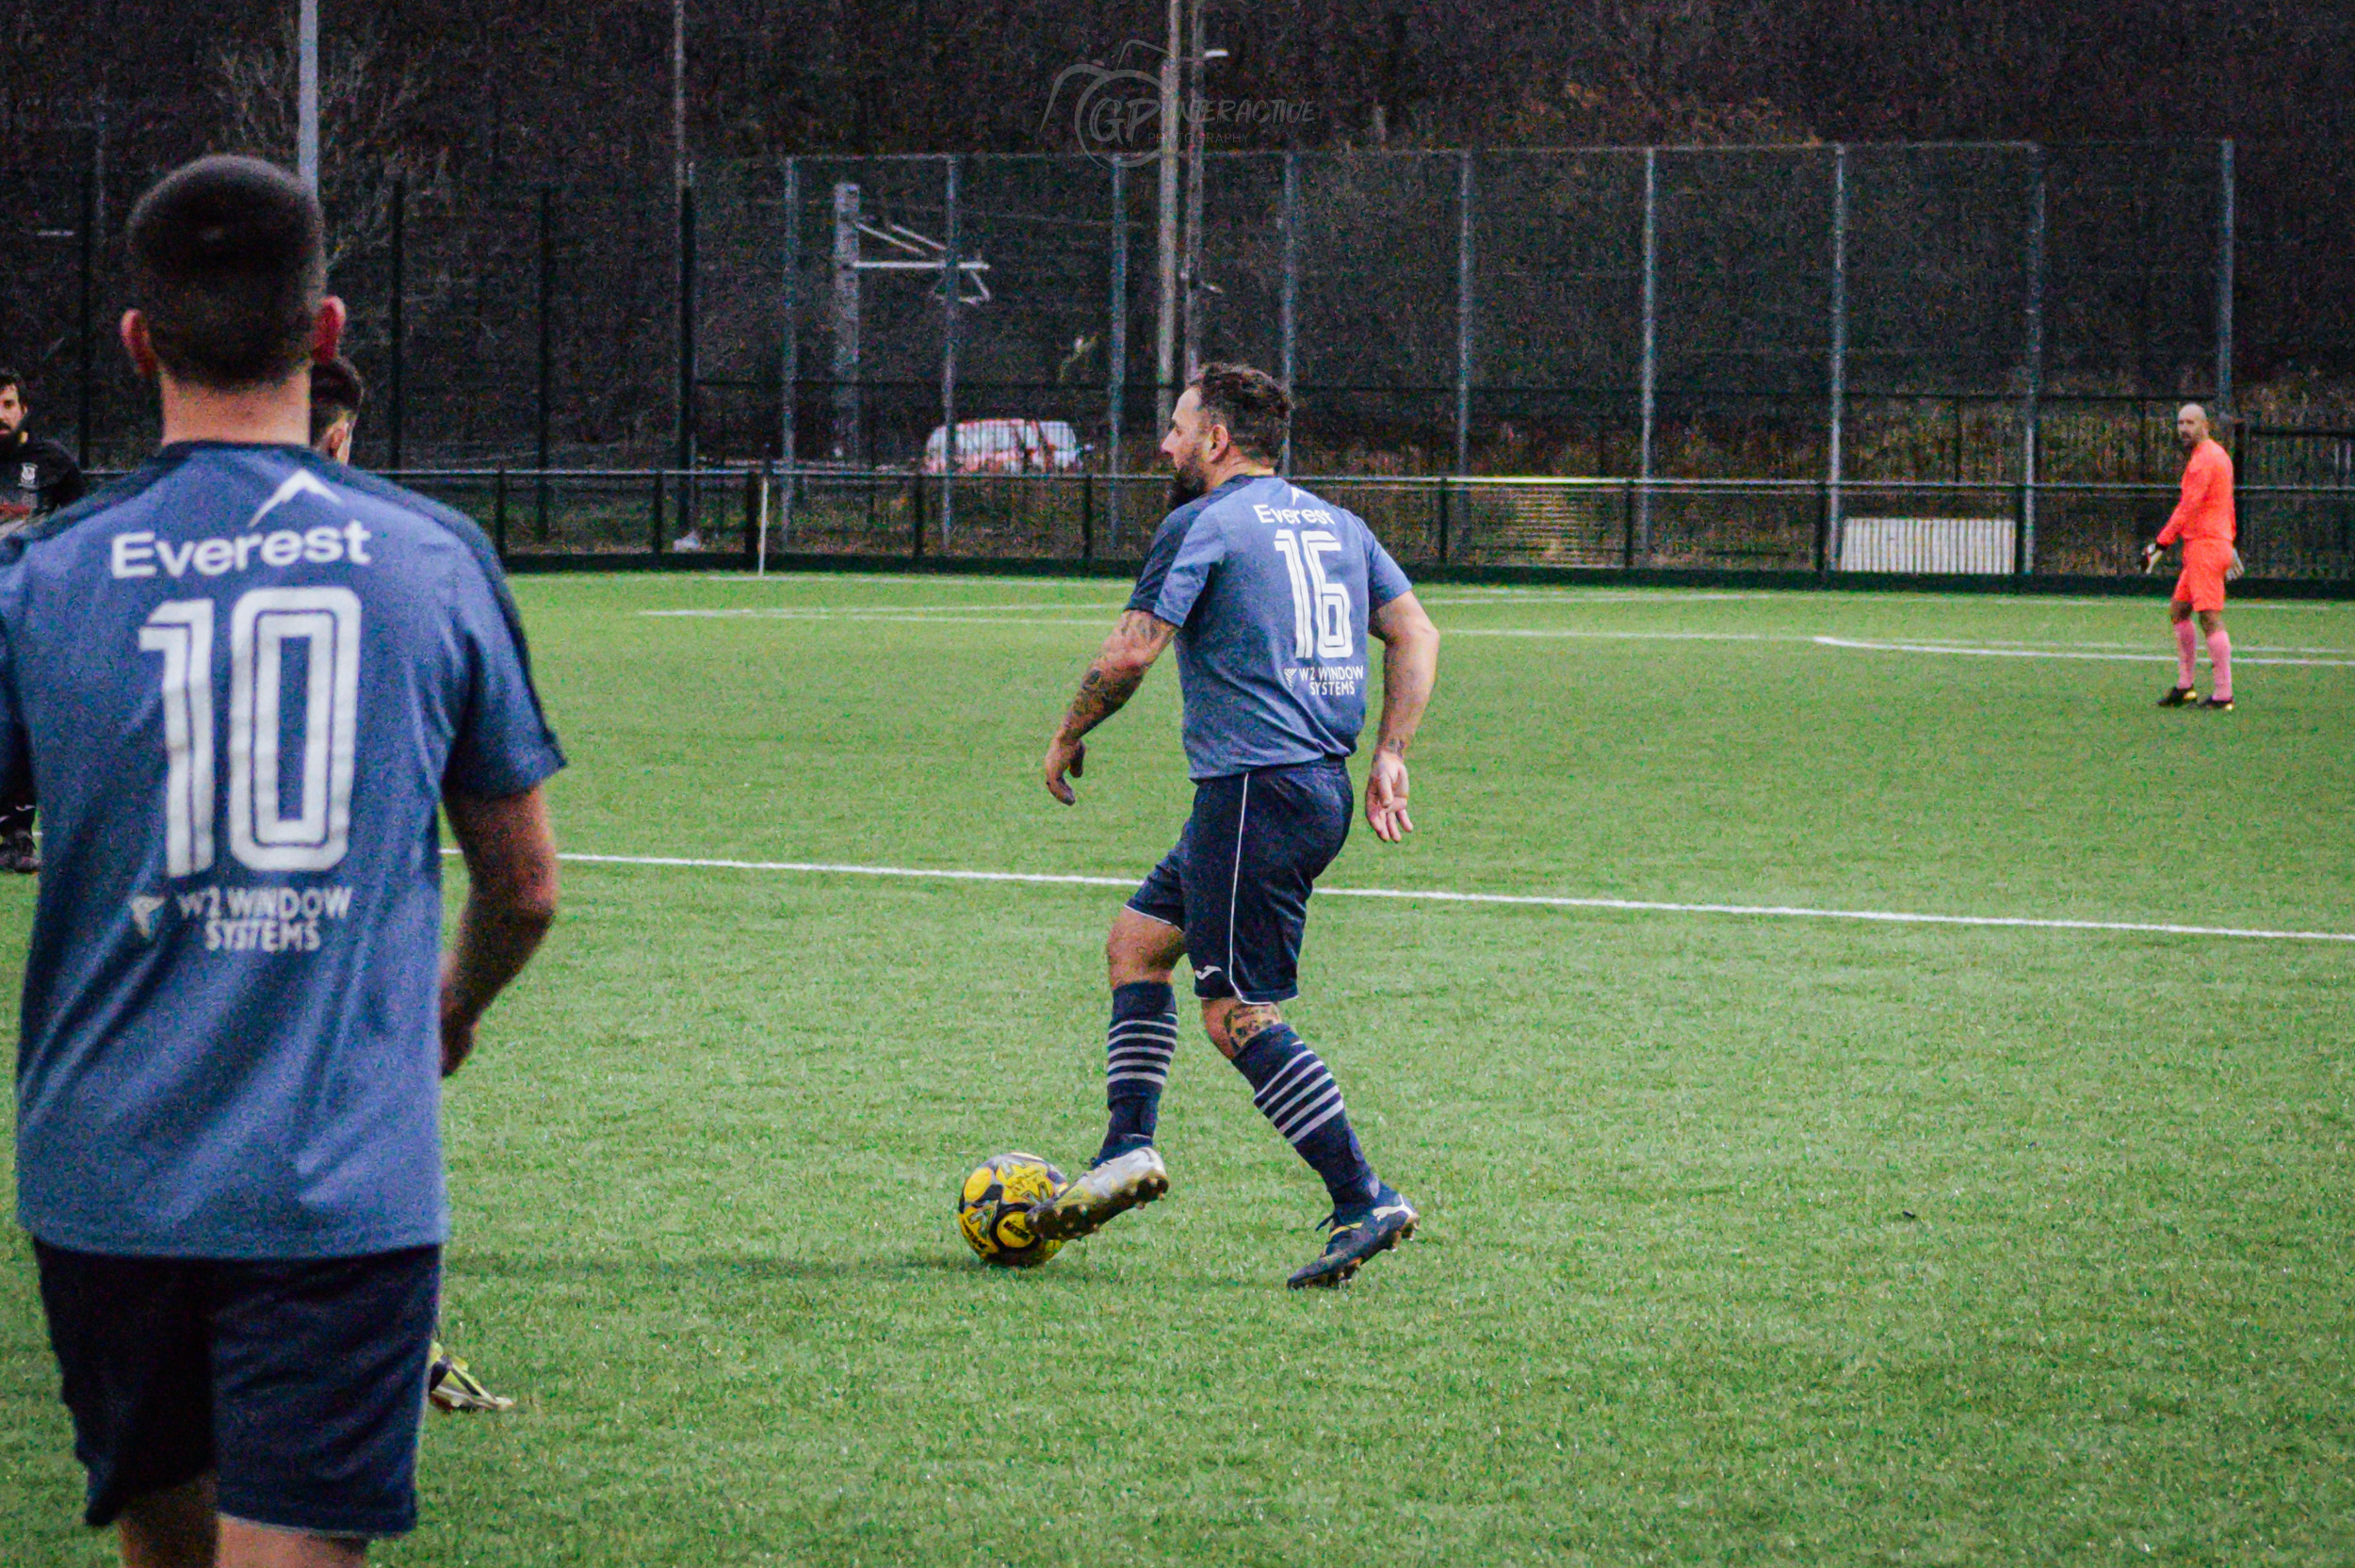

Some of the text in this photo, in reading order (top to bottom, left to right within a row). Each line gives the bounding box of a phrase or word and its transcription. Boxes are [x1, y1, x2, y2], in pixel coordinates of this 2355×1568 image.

[1253, 504, 1335, 525] Everest
[111, 519, 372, 579] Everest
[1274, 529, 1354, 658] 16
[1299, 665, 1364, 681] W2 WINDOW
[1310, 681, 1356, 696] SYSTEMS
[138, 587, 362, 879] 10
[176, 887, 352, 921] W2 WINDOW
[204, 920, 320, 952] SYSTEMS
